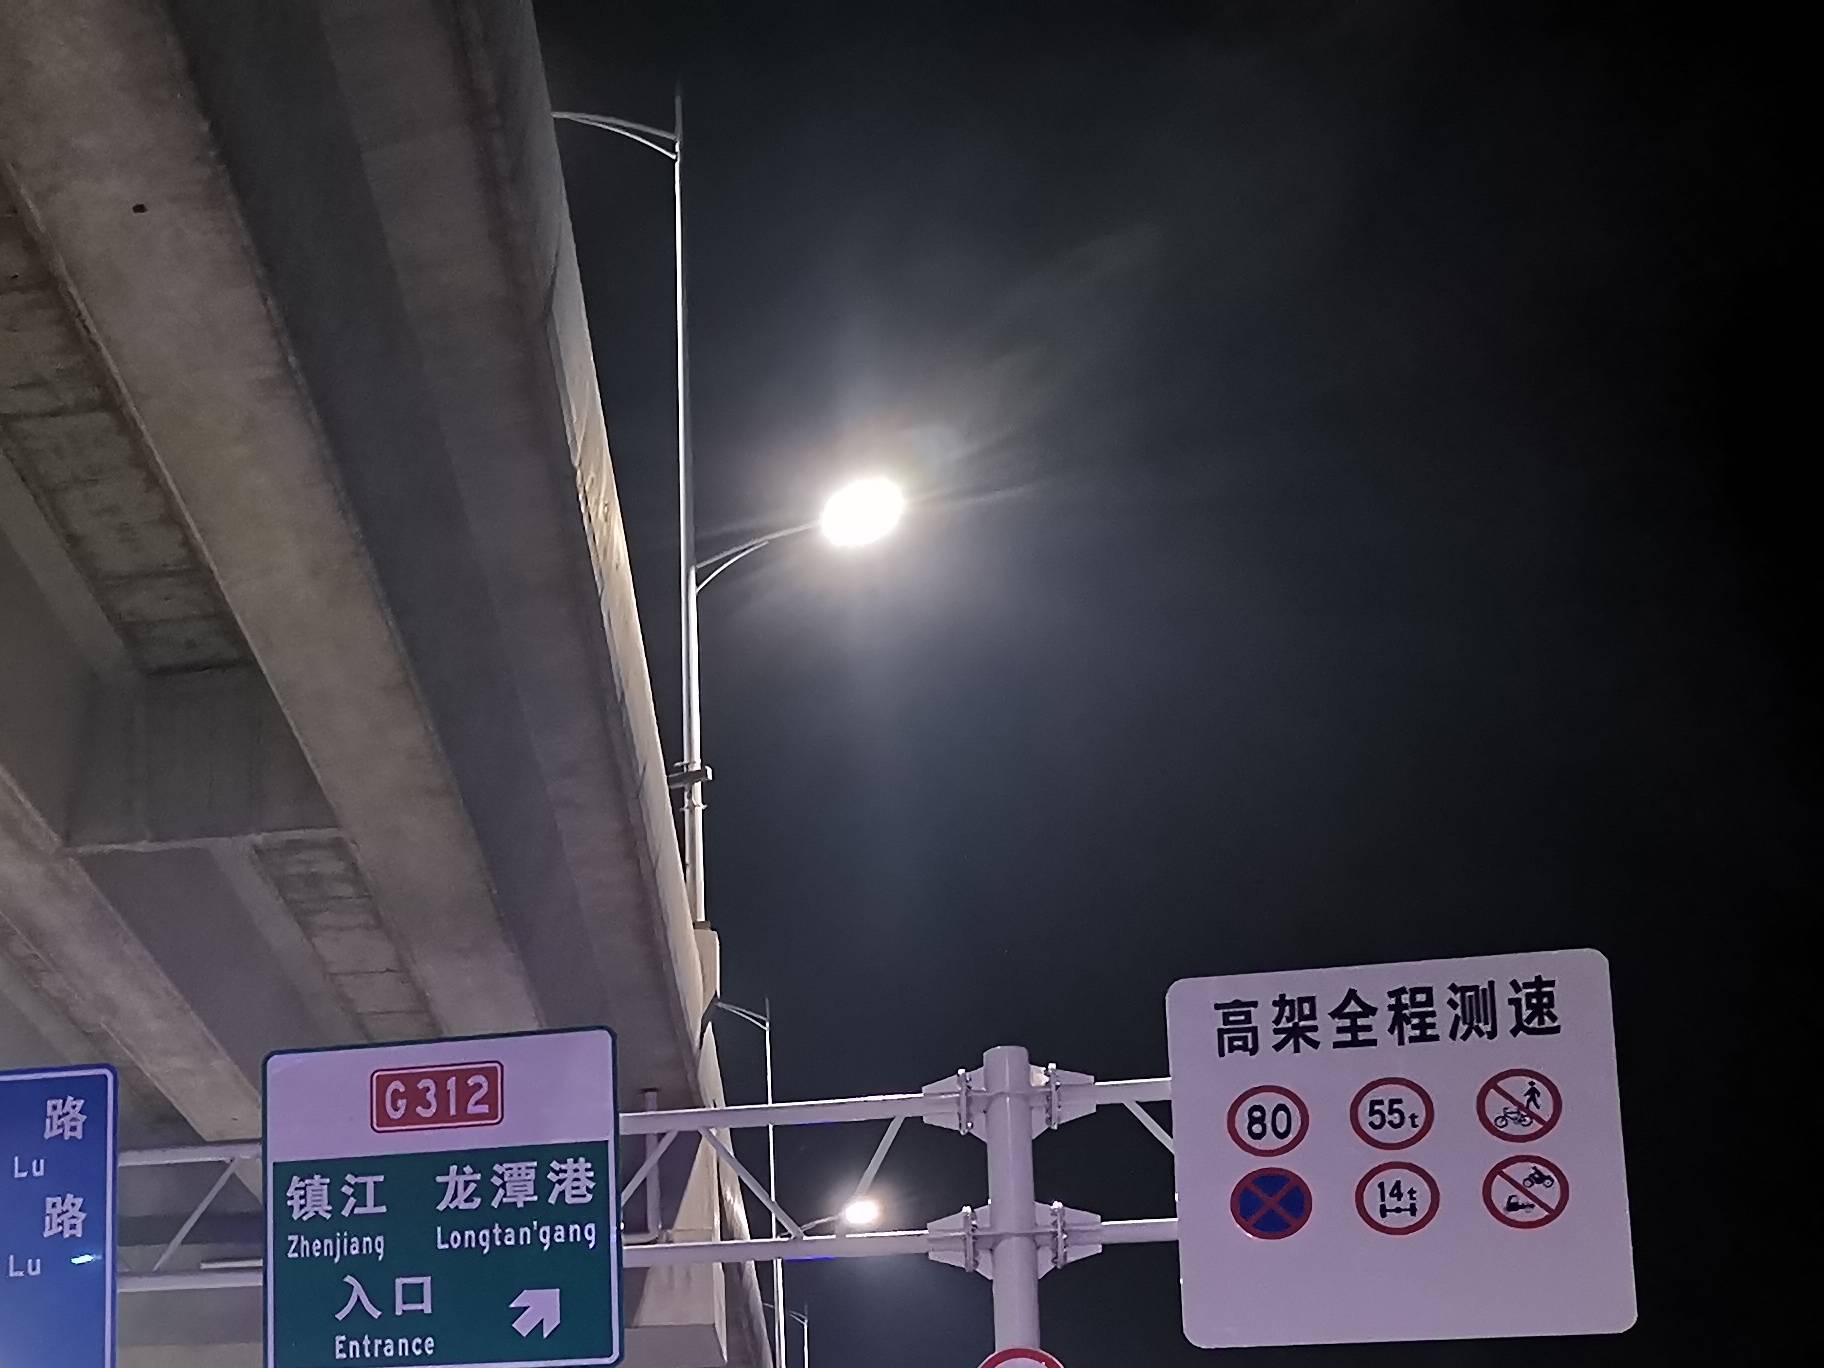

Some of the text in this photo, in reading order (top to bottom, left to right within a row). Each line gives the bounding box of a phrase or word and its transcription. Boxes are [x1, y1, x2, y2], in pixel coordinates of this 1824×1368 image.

[1213, 975, 1563, 1059] 高架全程测速
[384, 1074, 491, 1120] G312
[1246, 1104, 1293, 1141] 80
[14, 1156, 46, 1178] Lu
[285, 1156, 597, 1222] 镇江 龙潭港
[286, 1220, 597, 1264] Zhenjiang Longtan'gang
[8, 1255, 42, 1278] Lu
[334, 1274, 433, 1322] 入口
[334, 1334, 436, 1361] Entrance
